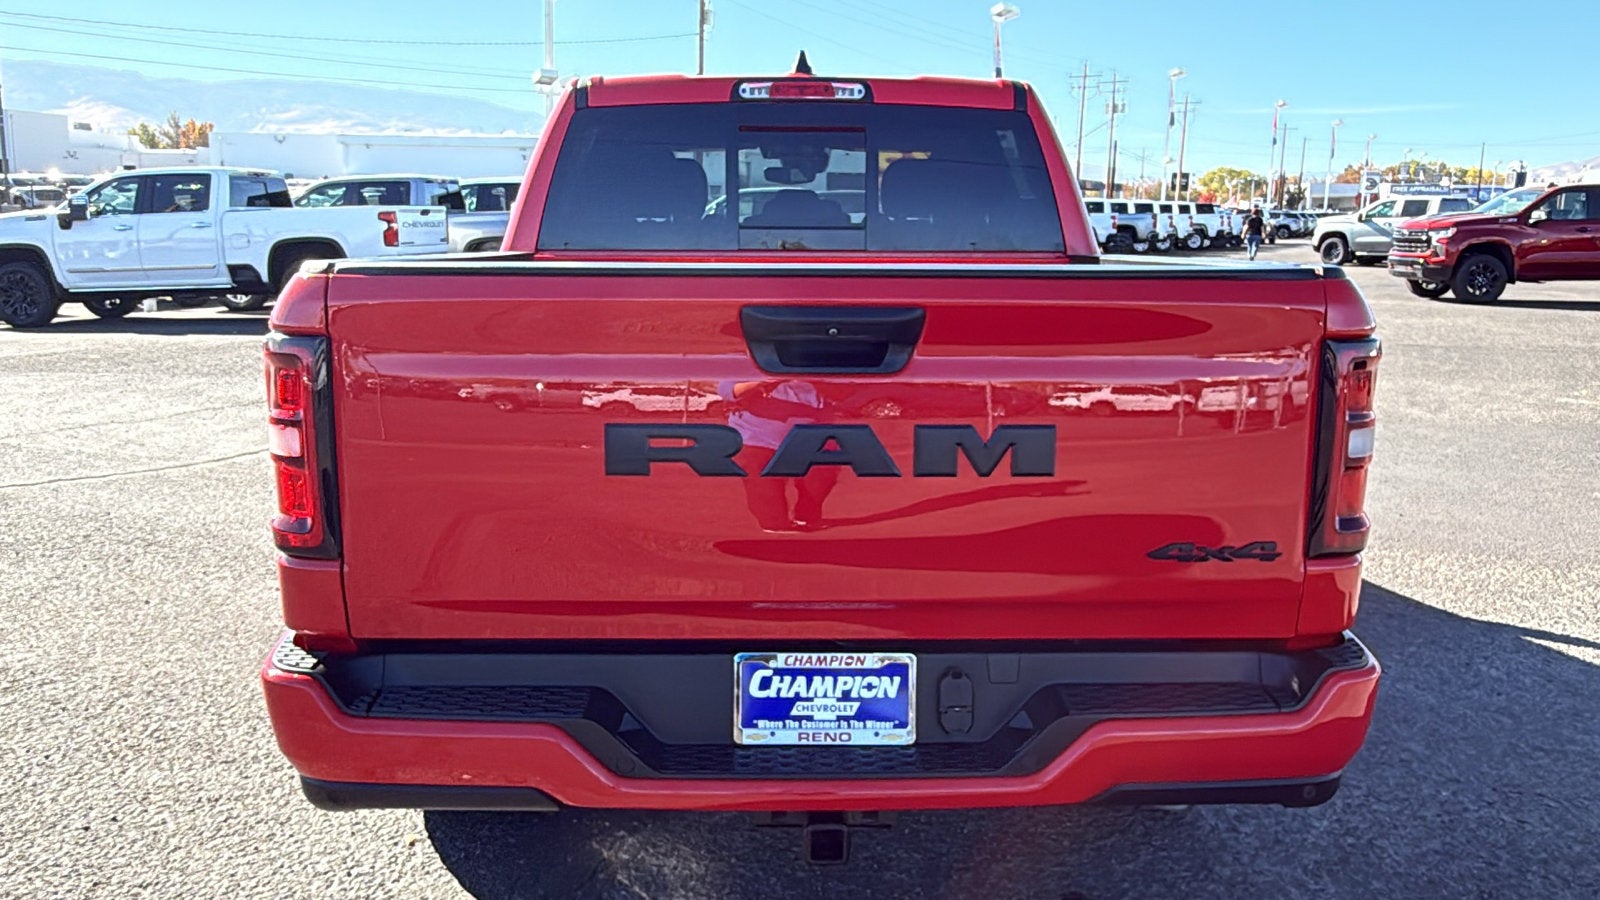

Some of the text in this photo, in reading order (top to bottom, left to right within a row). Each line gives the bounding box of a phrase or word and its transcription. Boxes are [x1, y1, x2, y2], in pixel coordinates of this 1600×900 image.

[604, 422, 1056, 478] RAM
[784, 655, 867, 667] CHAMPION
[749, 669, 901, 699] CHAMPION
[795, 704, 854, 713] CHEVROLET
[786, 720, 800, 729] The
[801, 720, 839, 729] Customer
[849, 720, 863, 729] The
[798, 732, 853, 742] RENO
